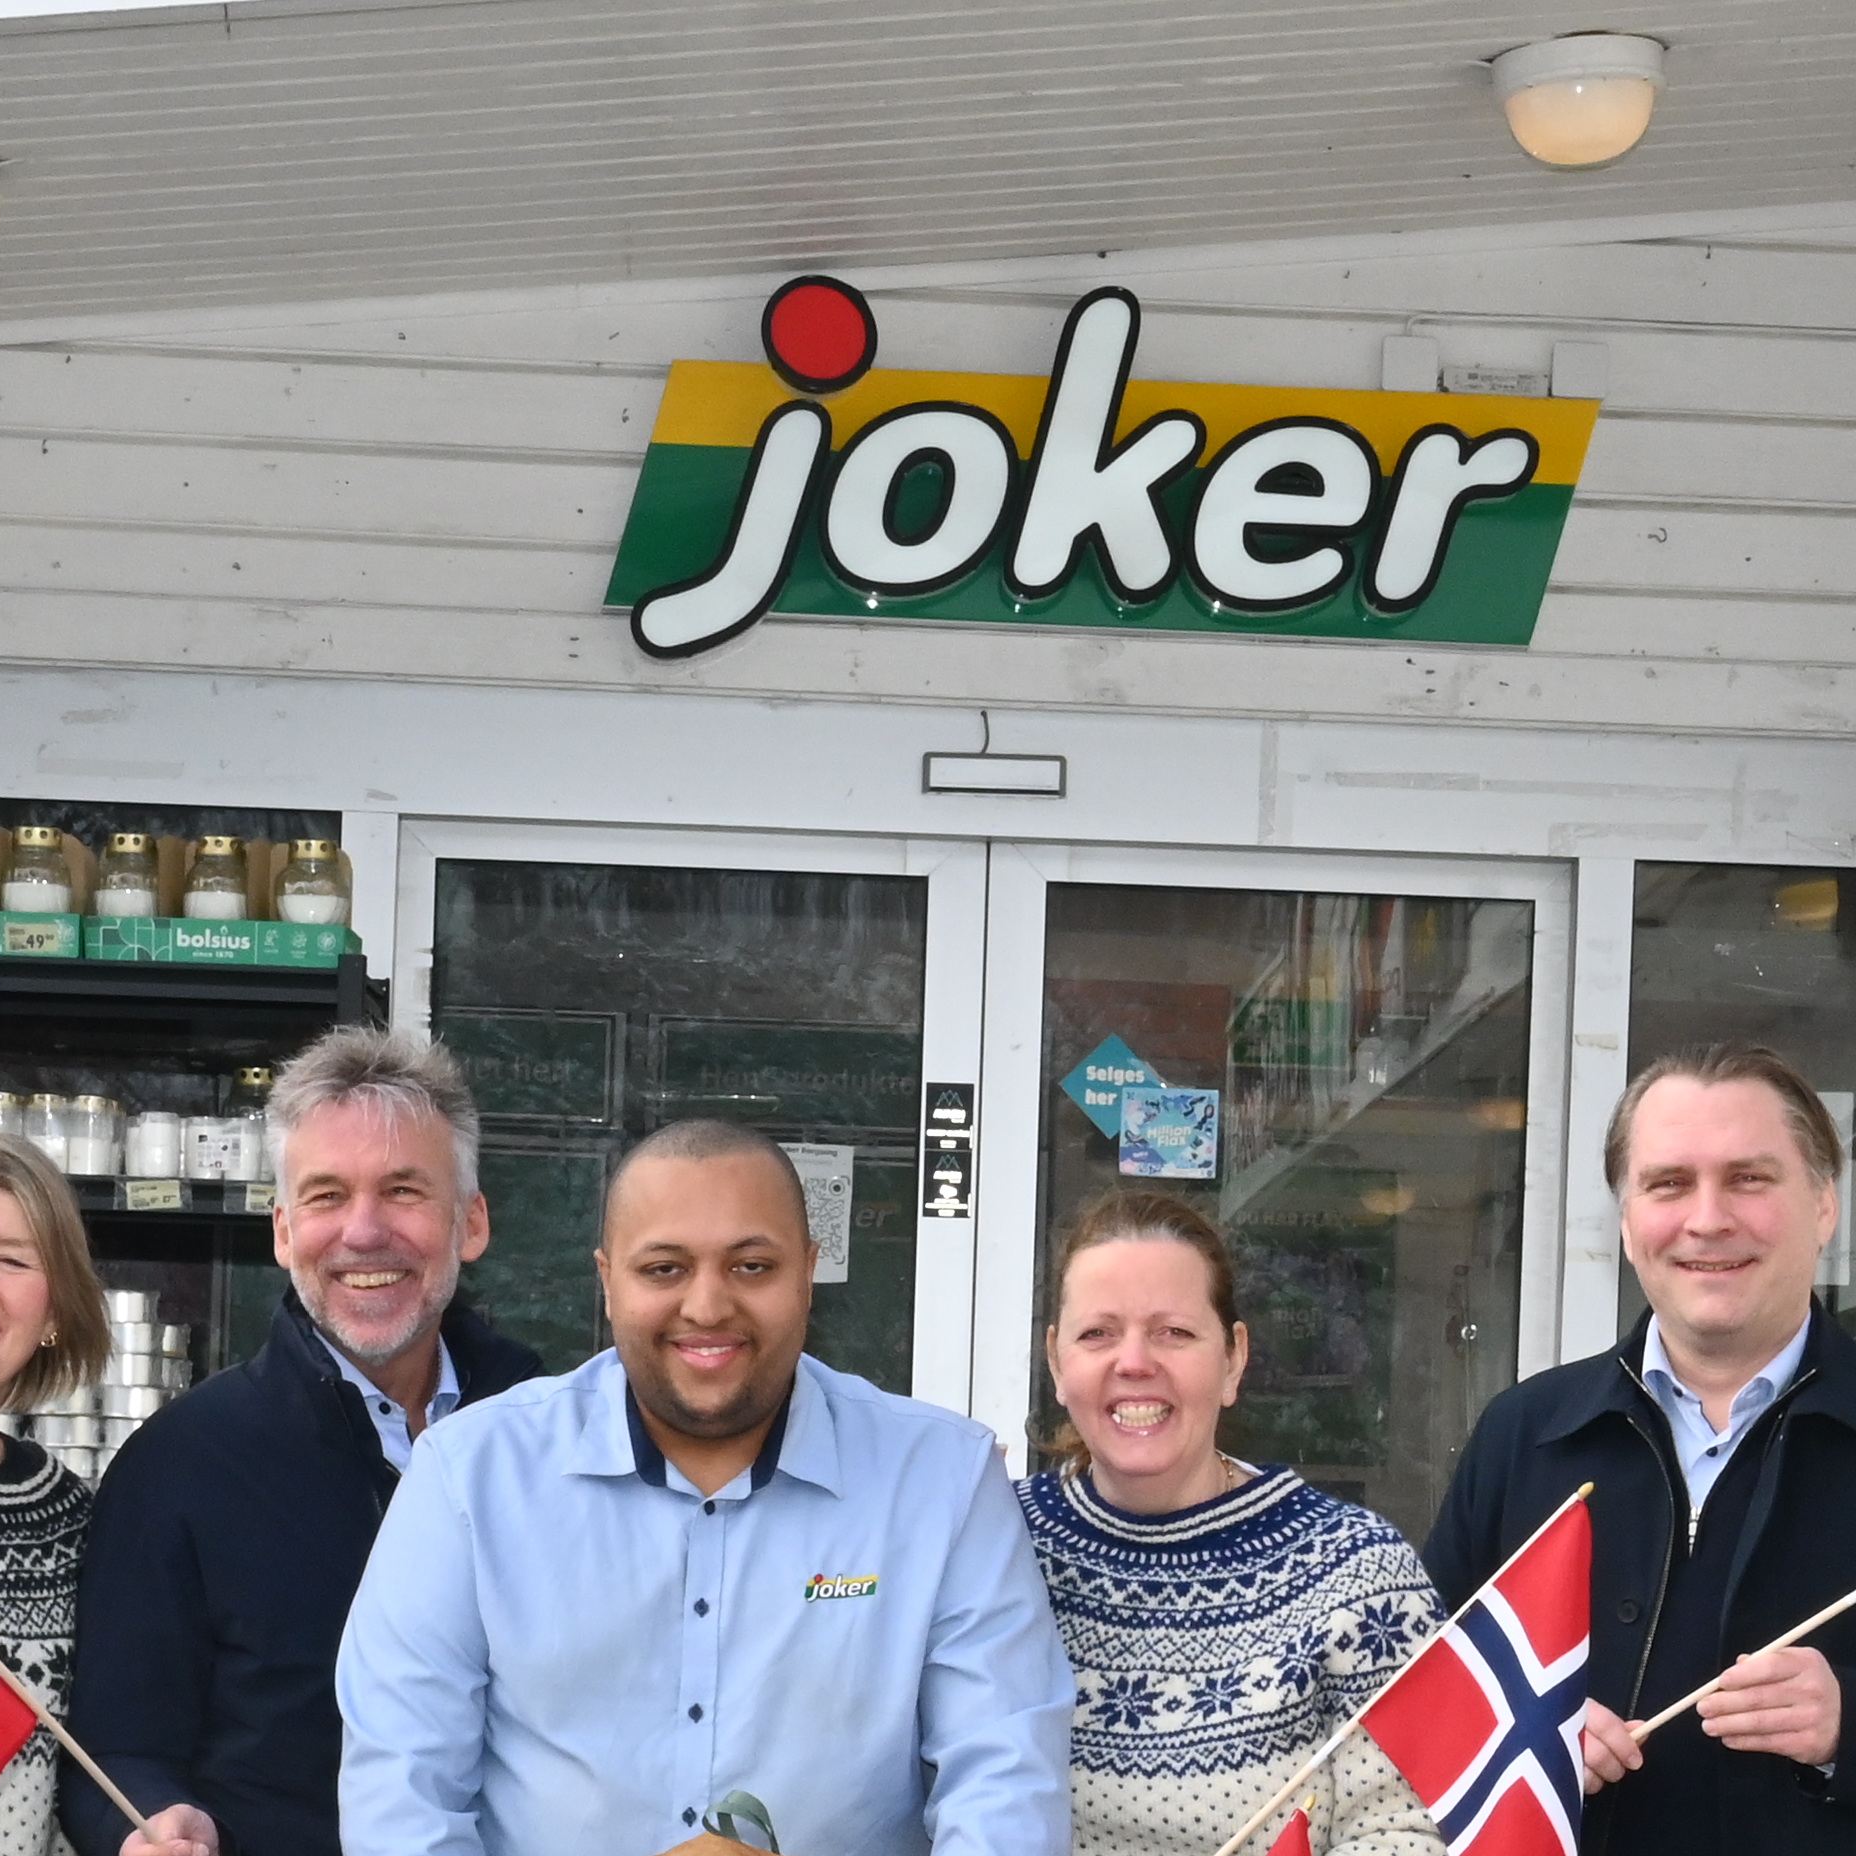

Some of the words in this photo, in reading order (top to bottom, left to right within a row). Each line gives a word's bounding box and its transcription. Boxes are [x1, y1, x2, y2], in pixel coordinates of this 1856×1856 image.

[631, 275, 1539, 659] joker
[176, 925, 251, 950] bolsius
[1086, 1065, 1145, 1086] Selges
[1085, 1088, 1117, 1106] her
[807, 1574, 874, 1602] joker
